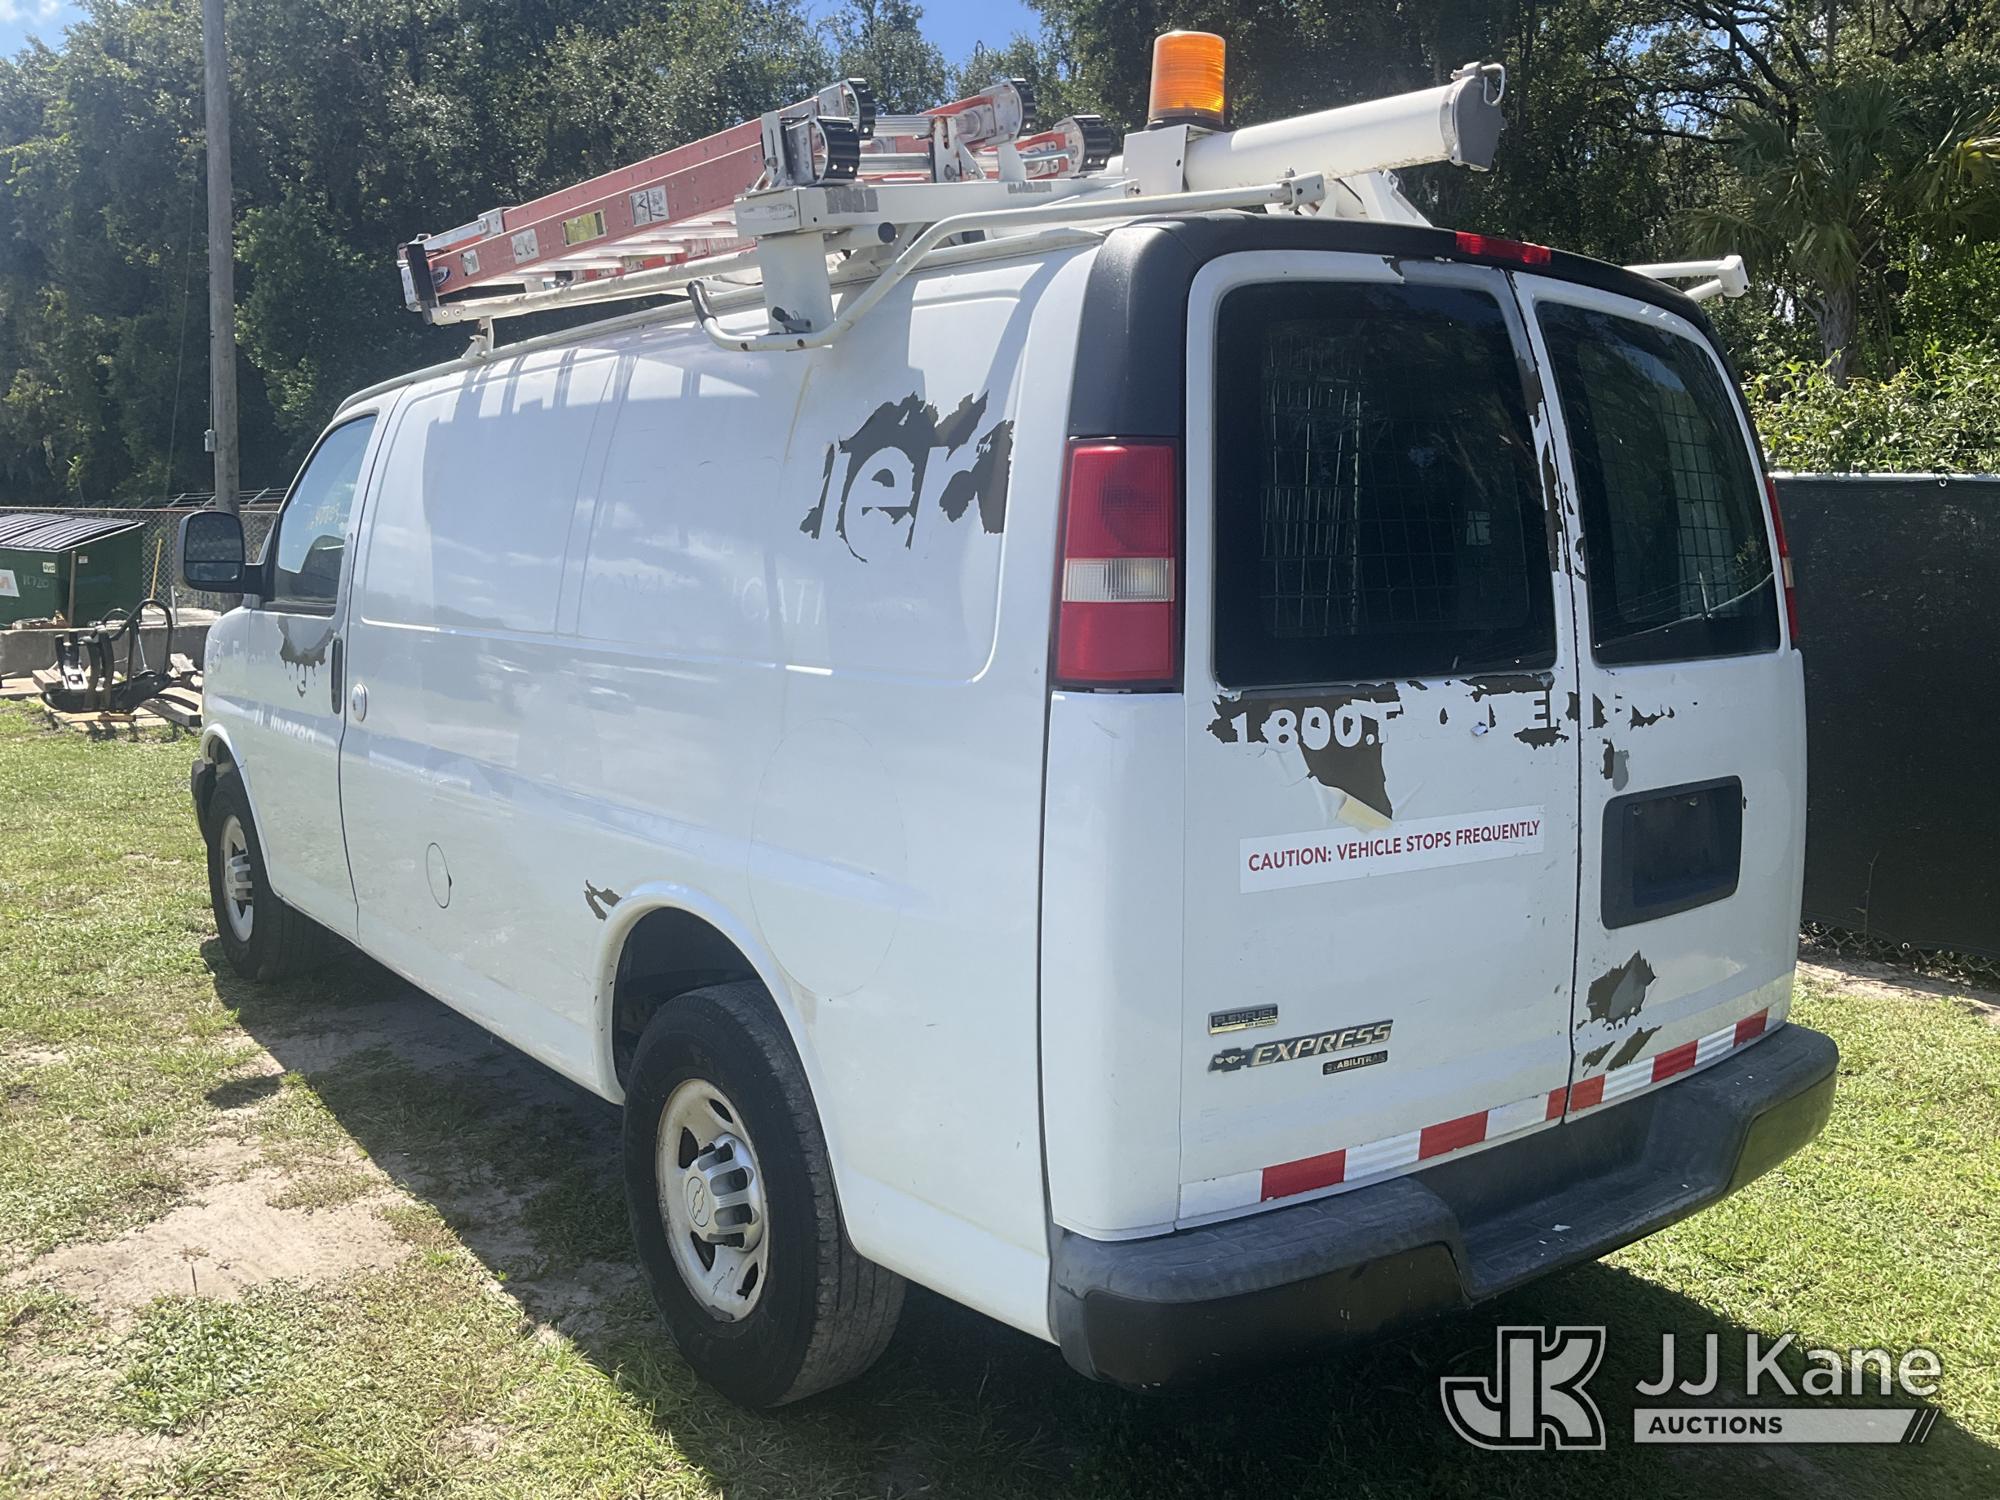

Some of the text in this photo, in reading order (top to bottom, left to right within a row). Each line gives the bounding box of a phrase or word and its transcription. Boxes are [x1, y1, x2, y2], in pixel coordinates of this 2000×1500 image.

[1248, 820, 1541, 872] CAUTION: VEHICLE STOPS FREQUENTLY
[1251, 1022, 1393, 1067] EXPRESS
